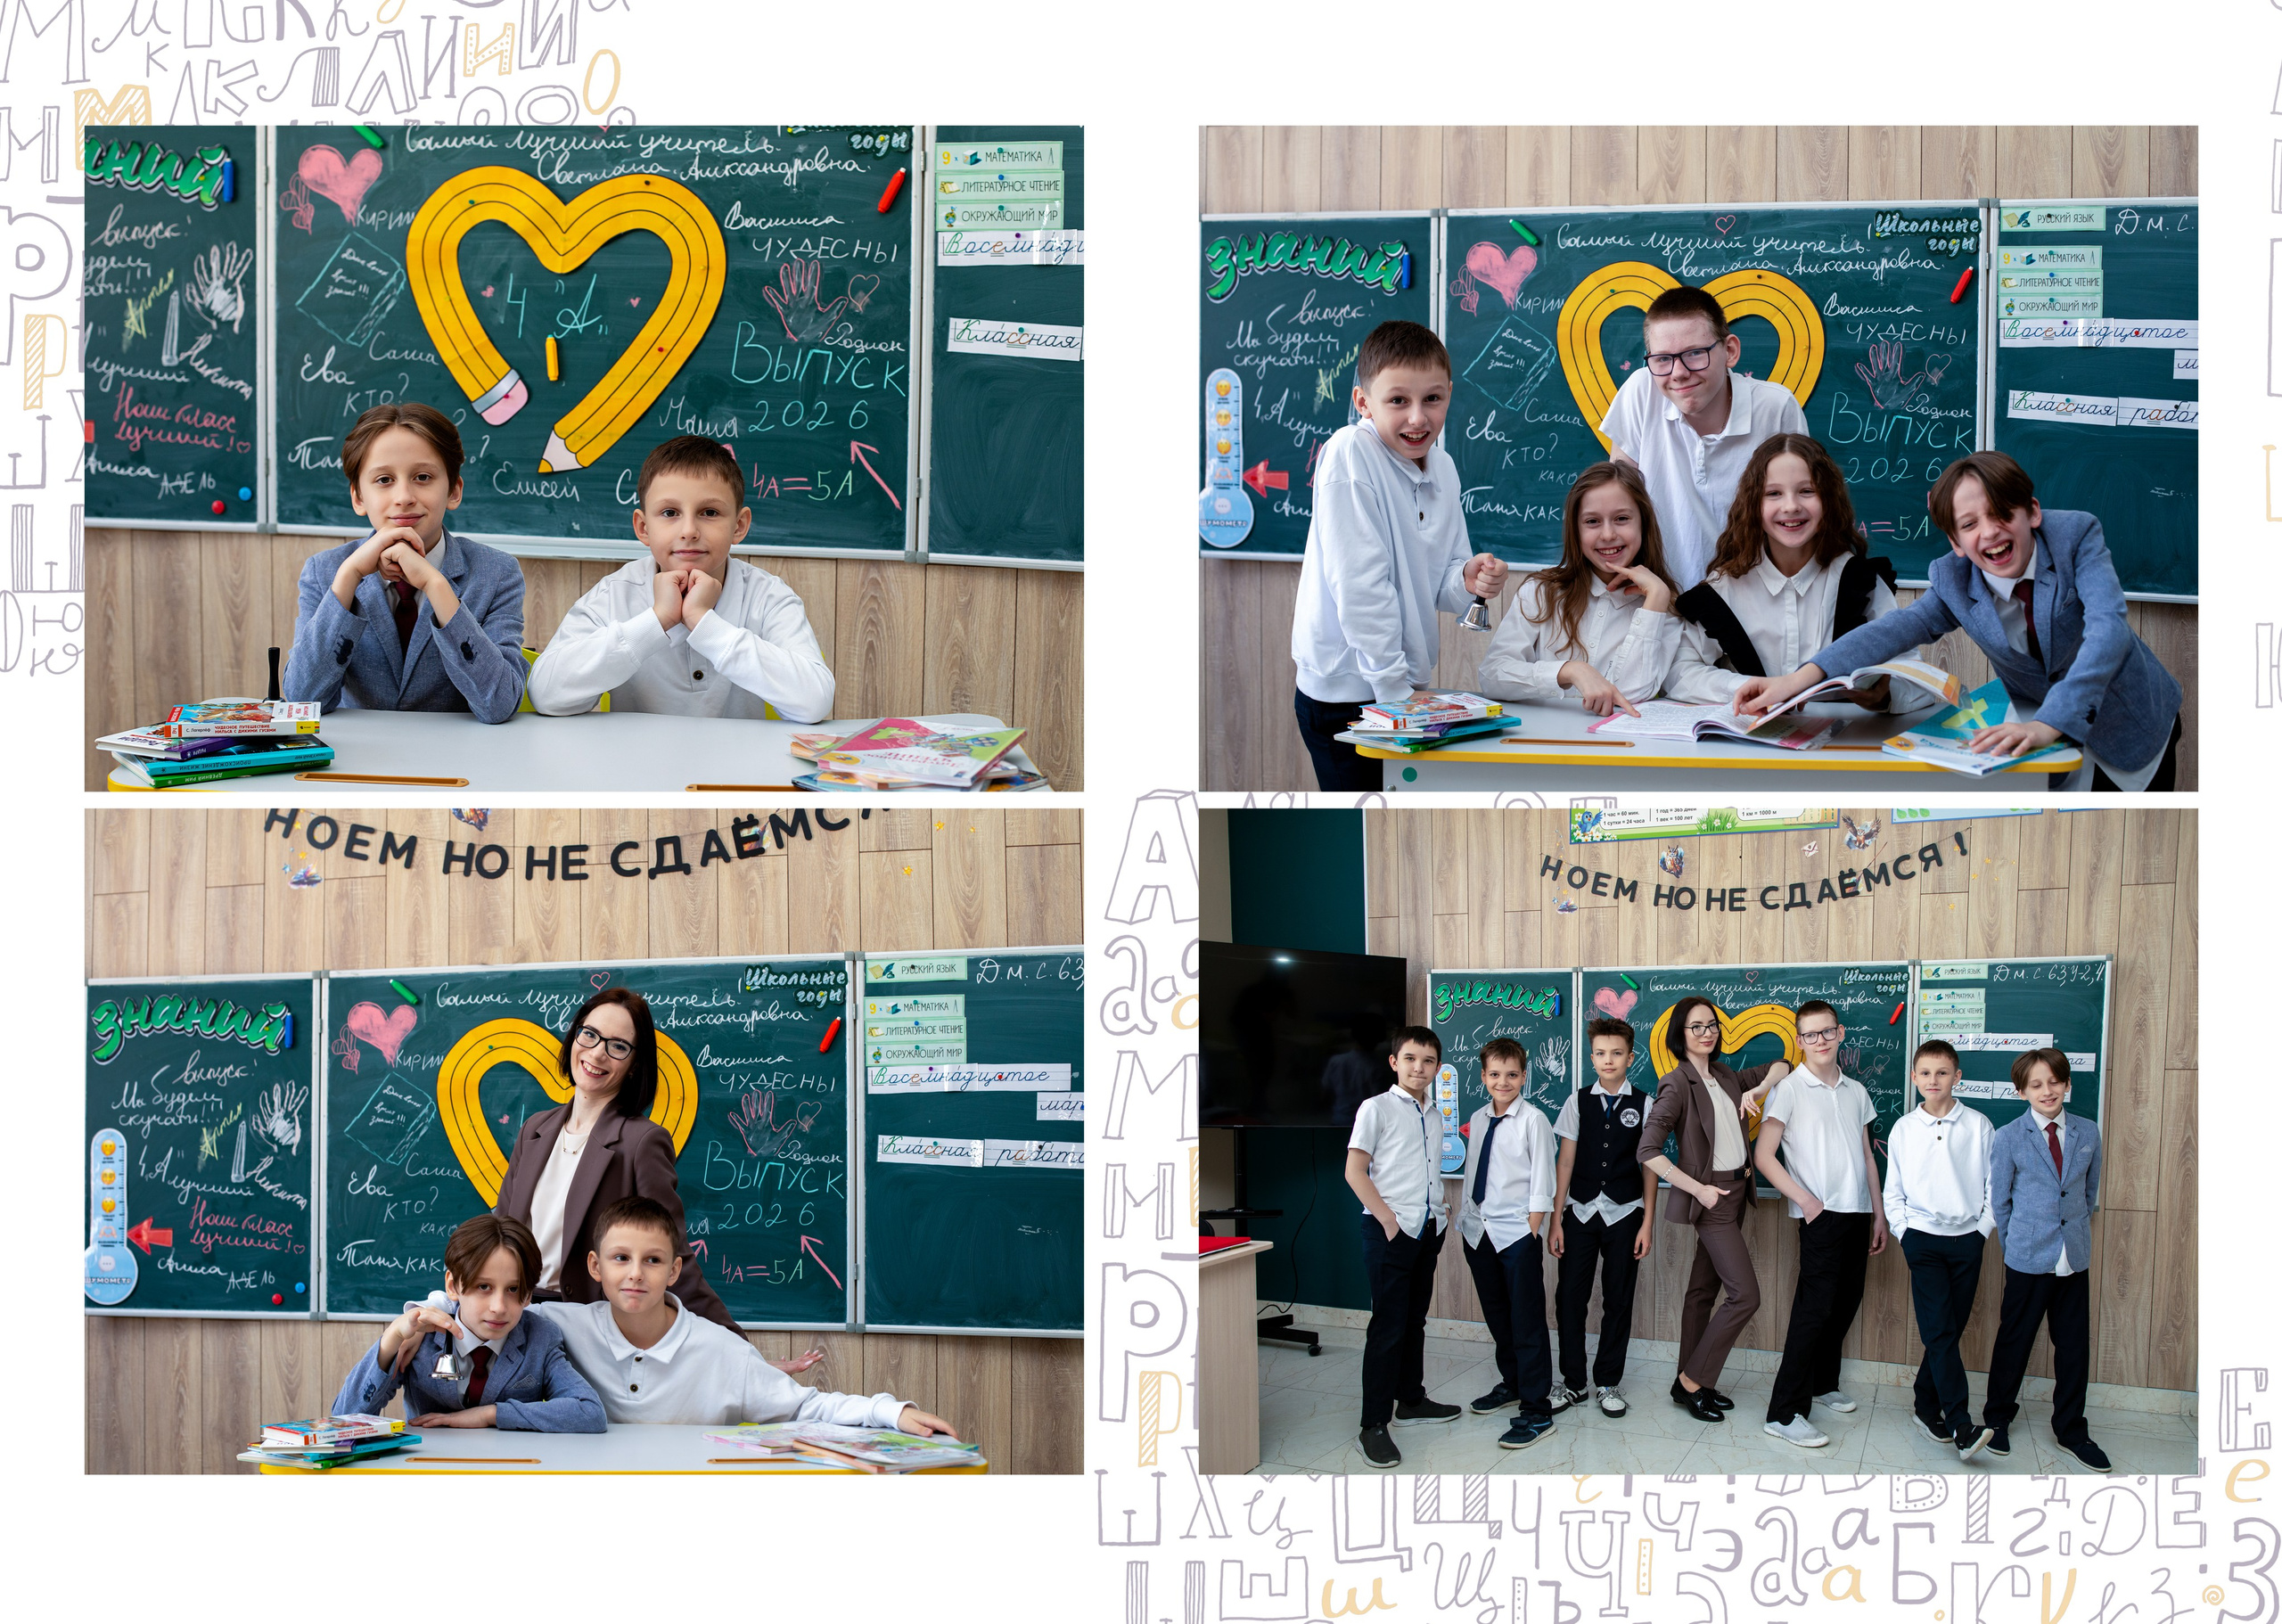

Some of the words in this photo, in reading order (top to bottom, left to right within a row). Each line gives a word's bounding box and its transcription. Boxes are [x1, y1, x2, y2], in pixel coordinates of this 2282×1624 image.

[850, 133, 907, 158] годы
[985, 151, 1043, 163] МАТЕМАТИКА
[961, 180, 1026, 193] ЛИТЕРАТУРНОЕ
[1030, 180, 1061, 192] ЧТЕНИЕ
[961, 209, 1035, 222] ОКРУЖАЮЩИЙ
[1038, 209, 1059, 221] МИР
[1876, 213, 1980, 234] Школьные
[2037, 212, 2071, 224] РУССКИЙ
[2073, 213, 2095, 223] ЯЗЫК
[1927, 236, 1975, 257] годы
[1205, 230, 1406, 303] знаний
[2039, 253, 2086, 263] МАТЕМАТИКА
[2019, 277, 2073, 288] ЛИТЕРАТУРНОЕ
[2075, 277, 2100, 287] ЧТЕНИЕ
[2019, 300, 2079, 312] ОКРУЖАЮЩИЙ
[2082, 301, 2098, 312] МИР
[368, 331, 439, 365] Саша
[300, 345, 356, 385] Ева
[1524, 398, 1585, 427] Саша
[1465, 409, 1513, 443] Ева
[201, 760, 251, 769] ПРОИСХОЖДЕНИЕ
[198, 773, 223, 781] ДРЕВНИЙ
[265, 808, 419, 869] НОЕМ
[443, 840, 510, 880] НО
[525, 844, 589, 882] НЕ
[1540, 855, 1638, 903] НОЕМ
[1653, 884, 1696, 909] НО
[1705, 887, 1746, 912] НЕ
[745, 967, 847, 990] Школьные
[901, 963, 933, 974] РУССКИЙ
[936, 964, 956, 973] ЯЗЫК
[1843, 968, 1909, 985] Школьные
[795, 988, 843, 1009] годы
[1876, 983, 1907, 997] годы
[903, 1001, 949, 1012] МАТЕМАТИКА
[1433, 980, 1558, 1024] знаний
[91, 993, 288, 1066] знаний
[885, 1026, 937, 1037] ЛИТЕРАТУРНОЕ
[940, 1025, 964, 1035] ЧТЕНИЕ
[1932, 1021, 1970, 1029] ОКРУЖАЮЩИЙ
[1972, 1021, 1982, 1029] МИР
[885, 1047, 944, 1059] ОКРУЖАЮЩИЙ
[947, 1048, 963, 1058] МИР
[406, 1152, 464, 1179] Саша
[348, 1164, 393, 1196] Ева
[718, 1202, 815, 1230] 2026
